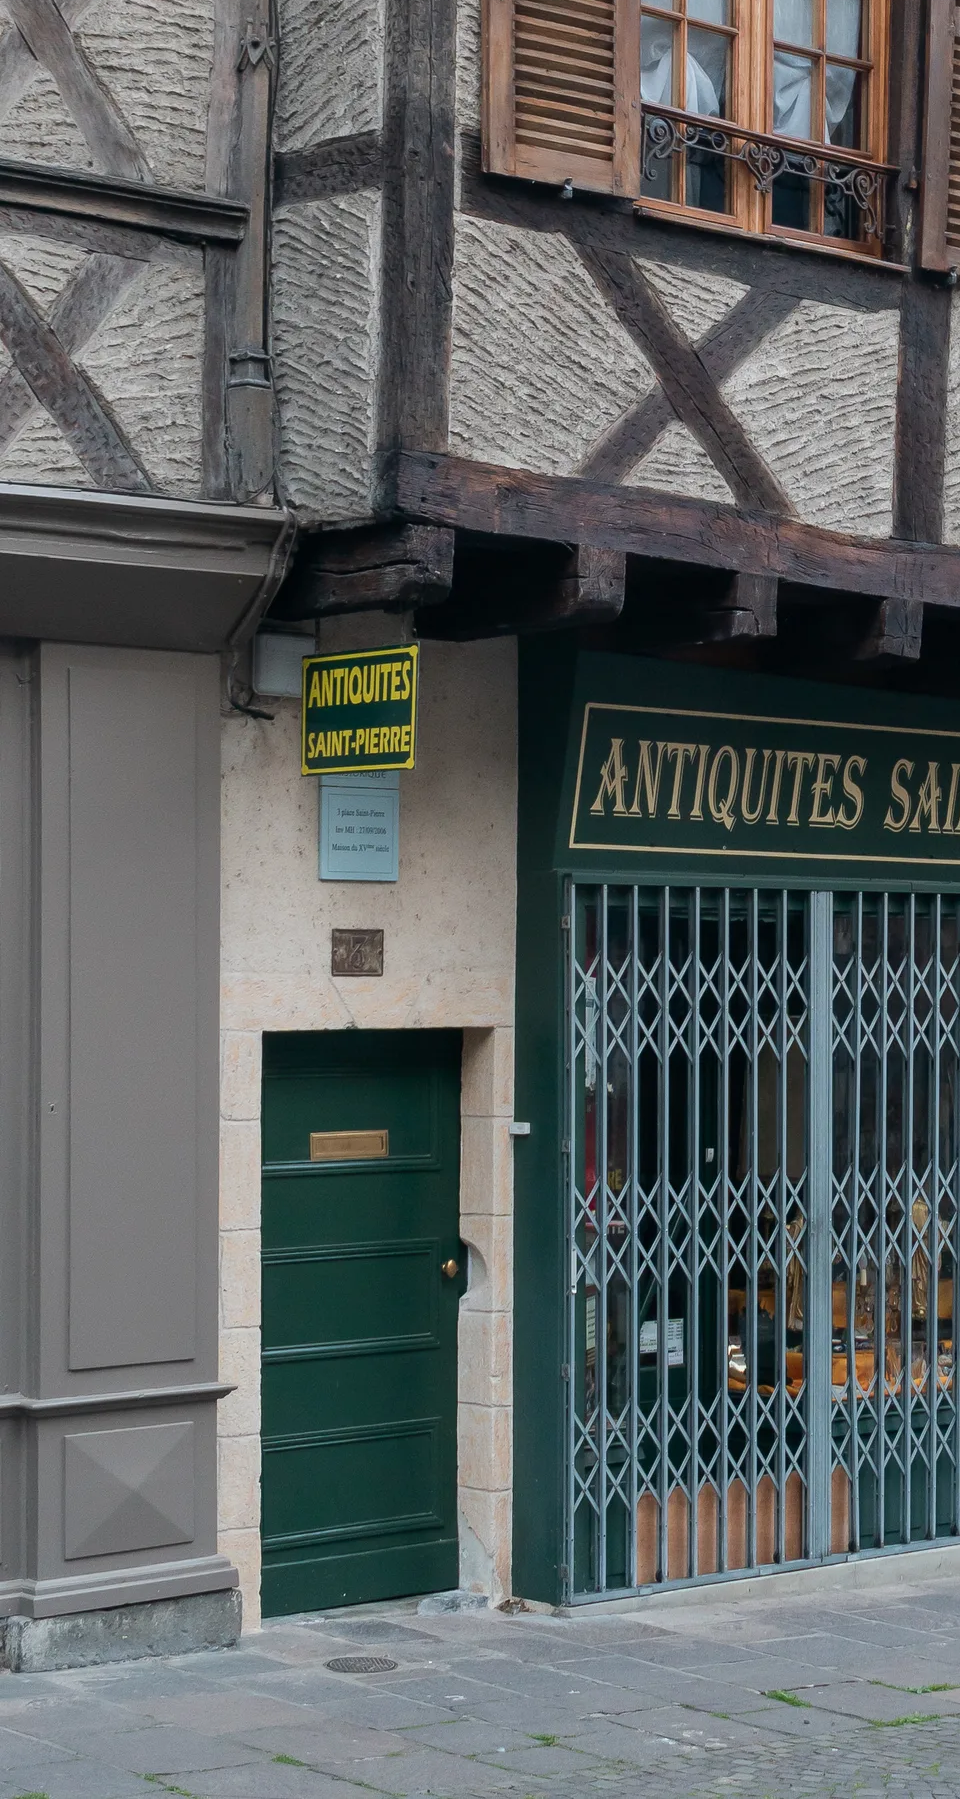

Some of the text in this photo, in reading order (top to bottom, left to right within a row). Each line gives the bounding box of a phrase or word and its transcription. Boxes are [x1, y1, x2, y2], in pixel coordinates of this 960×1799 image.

[308, 660, 411, 709] ANTIQUITES
[307, 724, 411, 759] SAINT-PIERRE
[589, 738, 868, 833] ANTIQUITES
[341, 808, 355, 818] place
[356, 808, 386, 818] Saint-Pierre
[332, 843, 351, 852] Maison
[351, 843, 358, 852] du
[349, 935, 369, 971] 3
